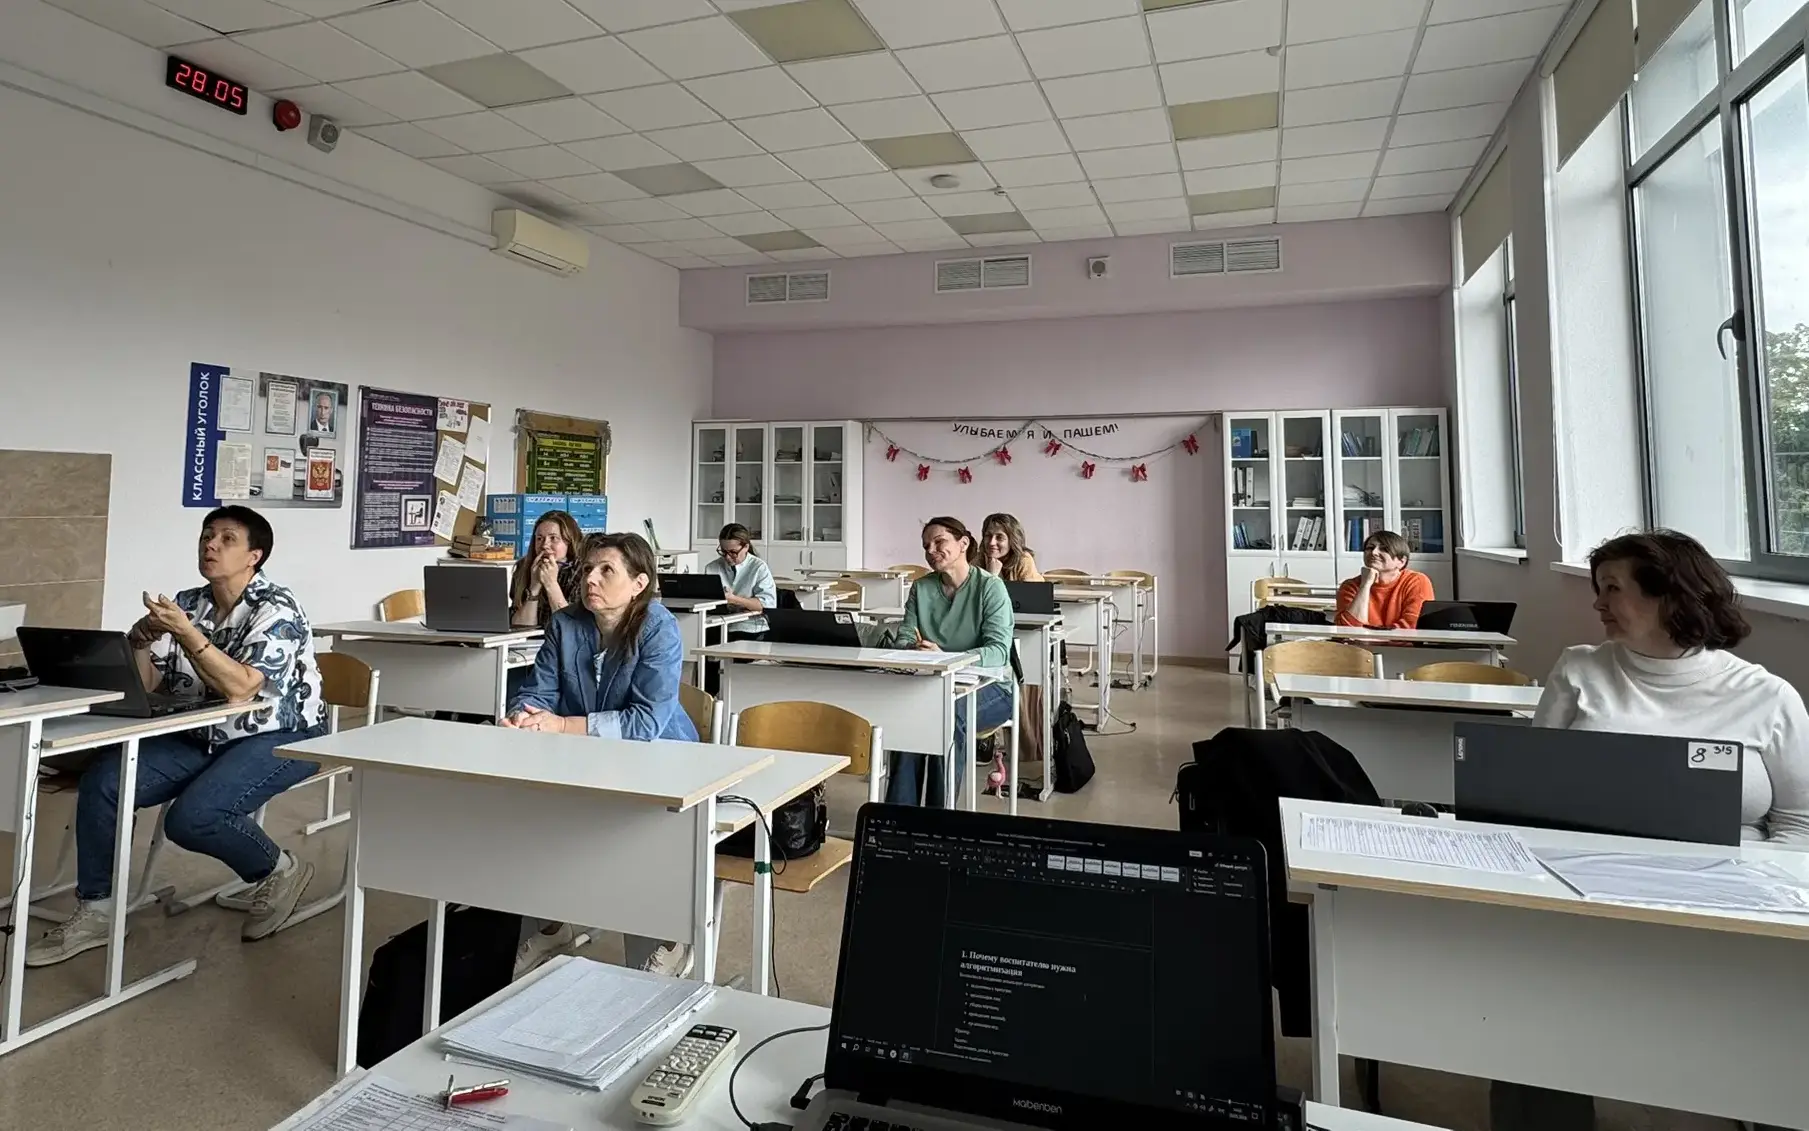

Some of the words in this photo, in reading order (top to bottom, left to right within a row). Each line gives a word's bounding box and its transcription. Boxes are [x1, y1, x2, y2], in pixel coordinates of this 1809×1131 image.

[175, 64, 243, 107] 28.05
[198, 372, 210, 424] УГОЛОК
[371, 402, 395, 412] ТЕХНИКА
[395, 404, 433, 416] БЕЗОПАСНОСТИ
[192, 429, 206, 500] КЛАССНЫЙ
[1691, 747, 1707, 763] 8
[960, 961, 1023, 977] алгоритмизация
[969, 951, 998, 963] Почему
[999, 956, 1050, 970] воспитателю
[1051, 963, 1077, 973] нужна
